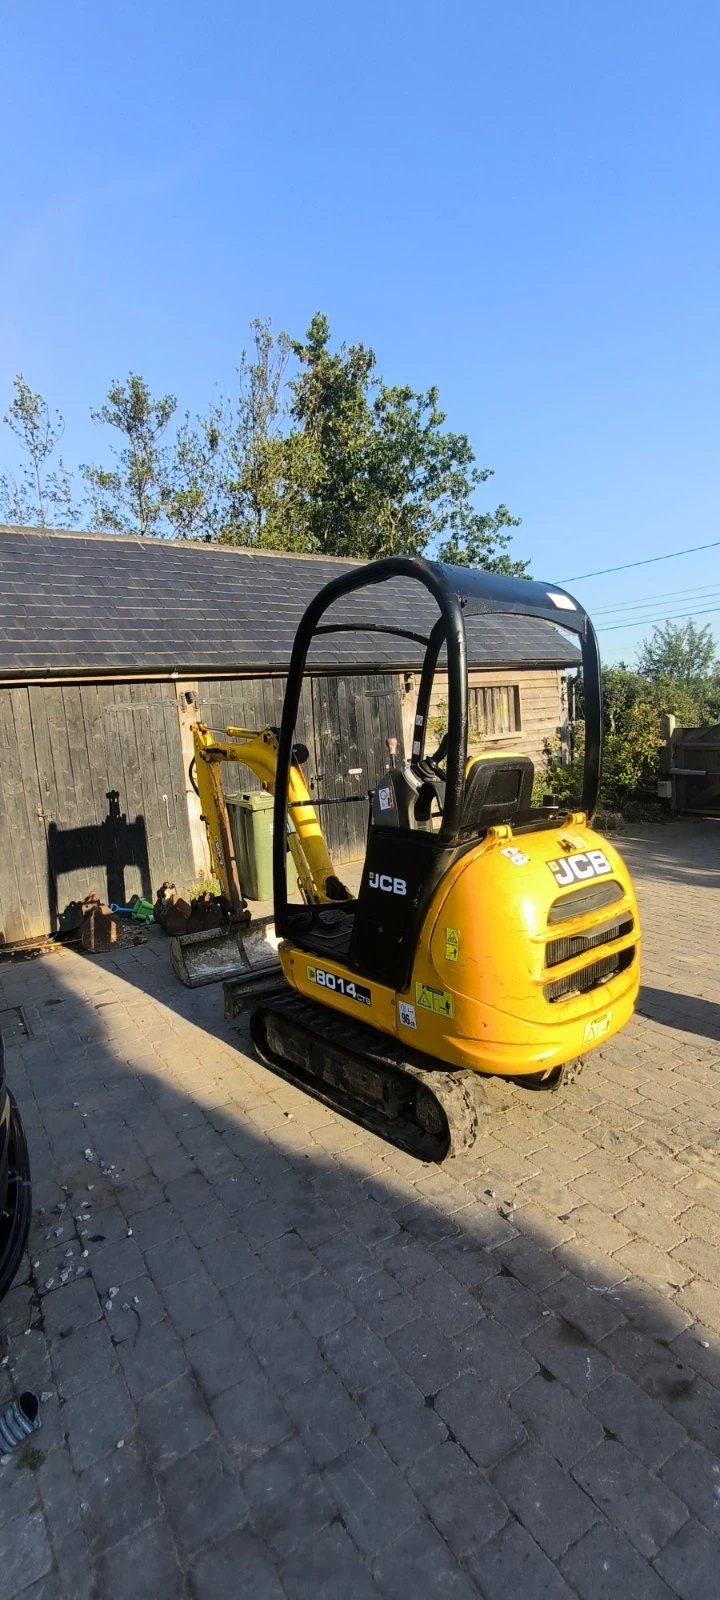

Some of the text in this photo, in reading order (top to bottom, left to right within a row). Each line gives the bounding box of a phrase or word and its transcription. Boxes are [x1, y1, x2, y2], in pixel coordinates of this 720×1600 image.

[555, 849, 612, 885] JCB
[369, 873, 407, 896] JCB
[316, 969, 356, 999] 8014
[401, 1012, 410, 1025] 96
